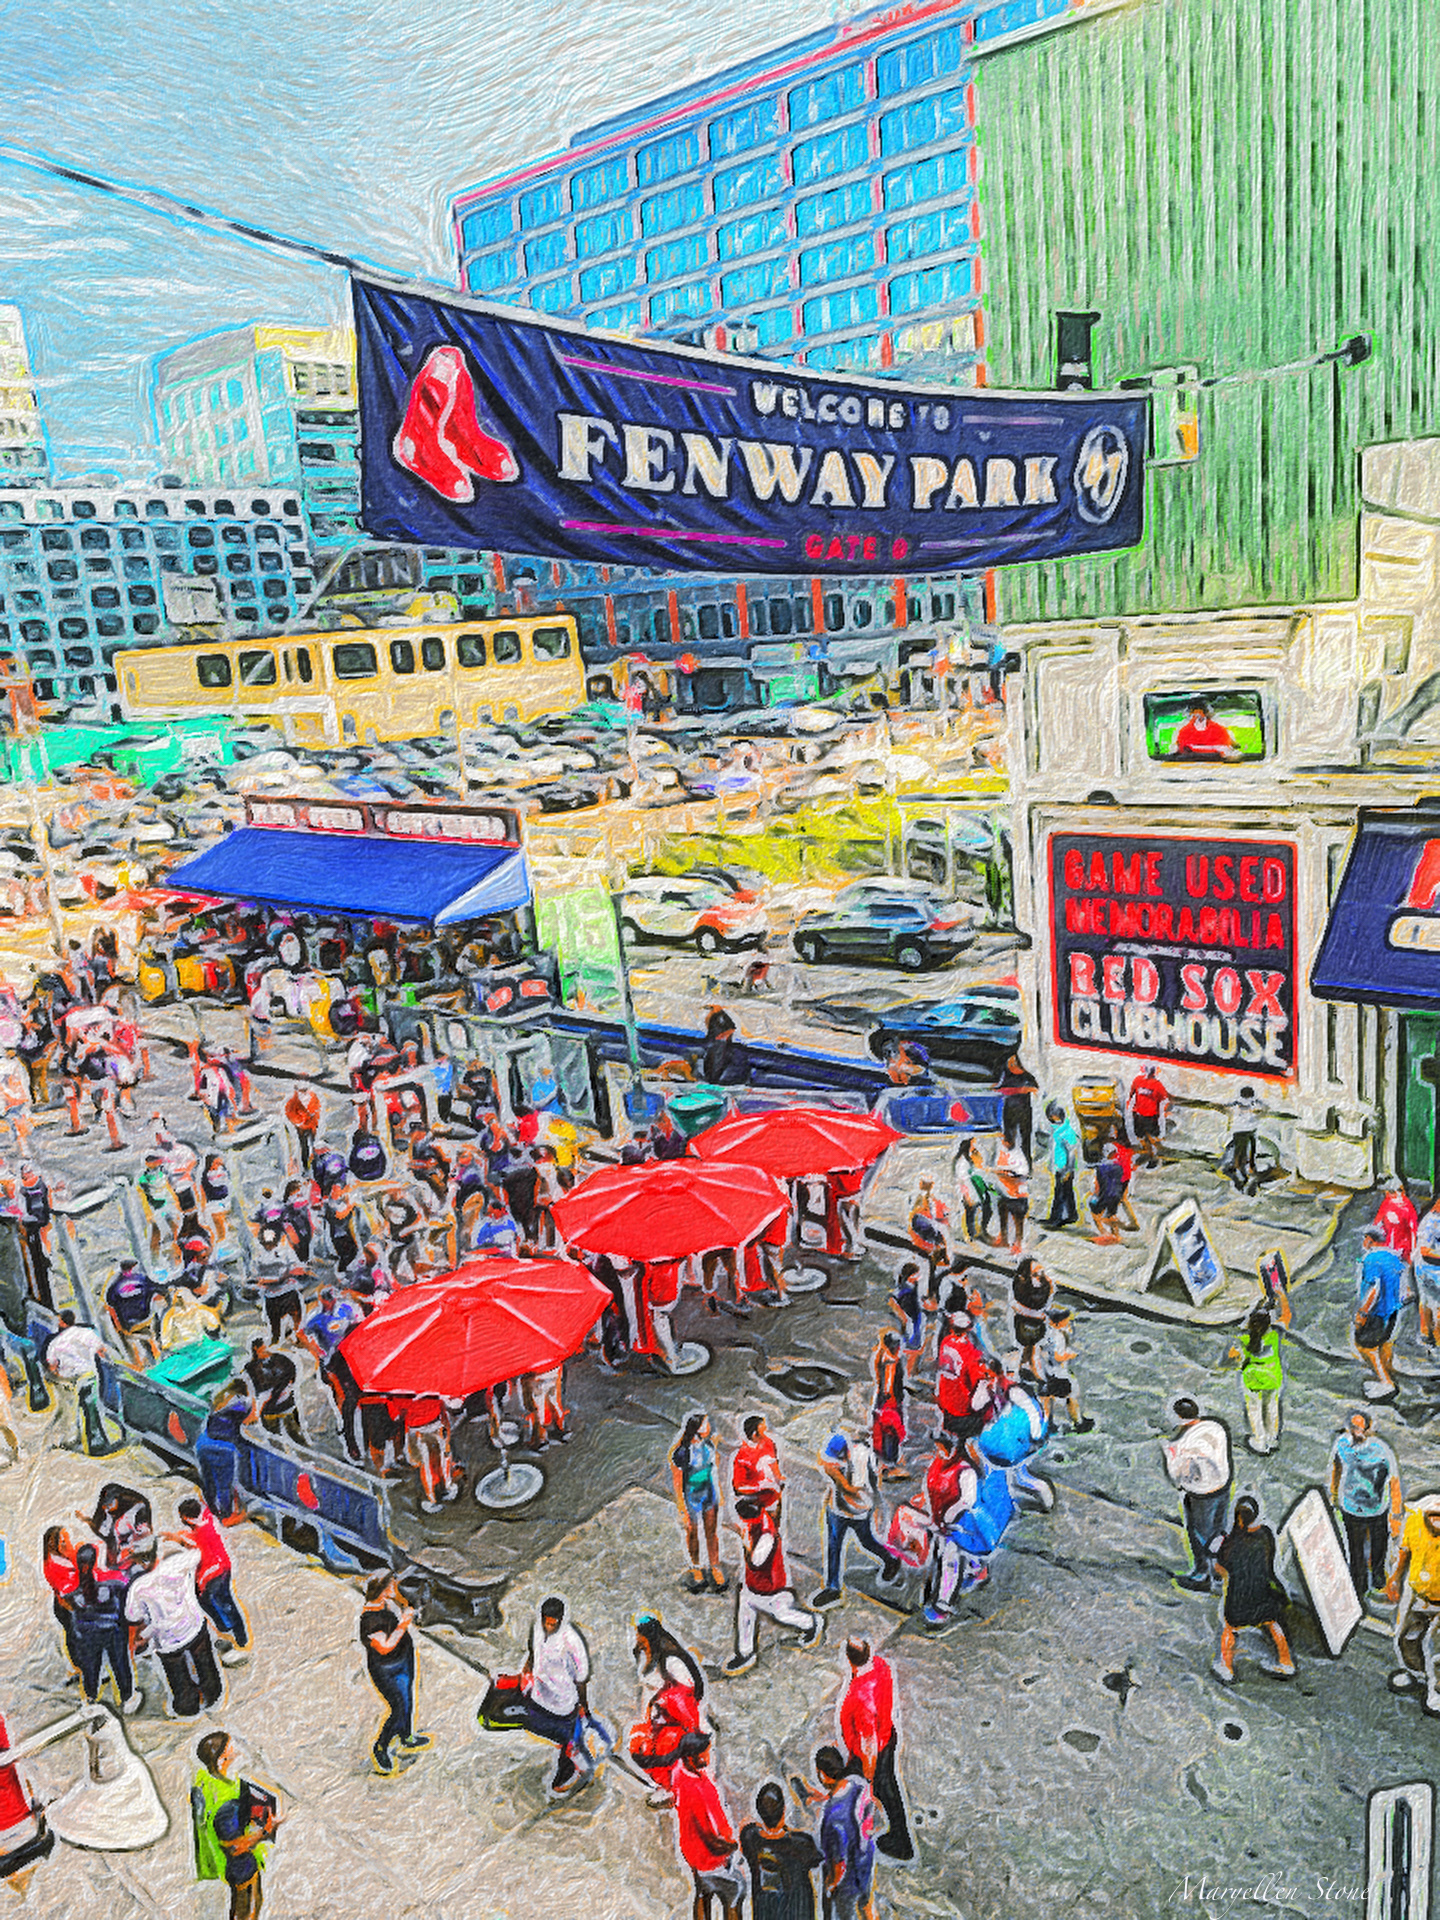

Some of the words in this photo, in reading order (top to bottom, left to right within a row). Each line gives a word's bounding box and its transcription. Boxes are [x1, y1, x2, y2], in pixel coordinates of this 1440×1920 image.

[752, 380, 906, 429] WELCOME
[557, 412, 894, 509] FENWAY
[910, 455, 1059, 509] PARK
[804, 533, 877, 561] GATE
[1064, 848, 1163, 896] GAME
[1185, 854, 1287, 904] USED
[1065, 896, 1285, 949] MEMORABILIA
[1069, 952, 1160, 1005] RED
[1180, 963, 1287, 1019] SOX
[1070, 999, 1289, 1070] CLUBHOUSE
